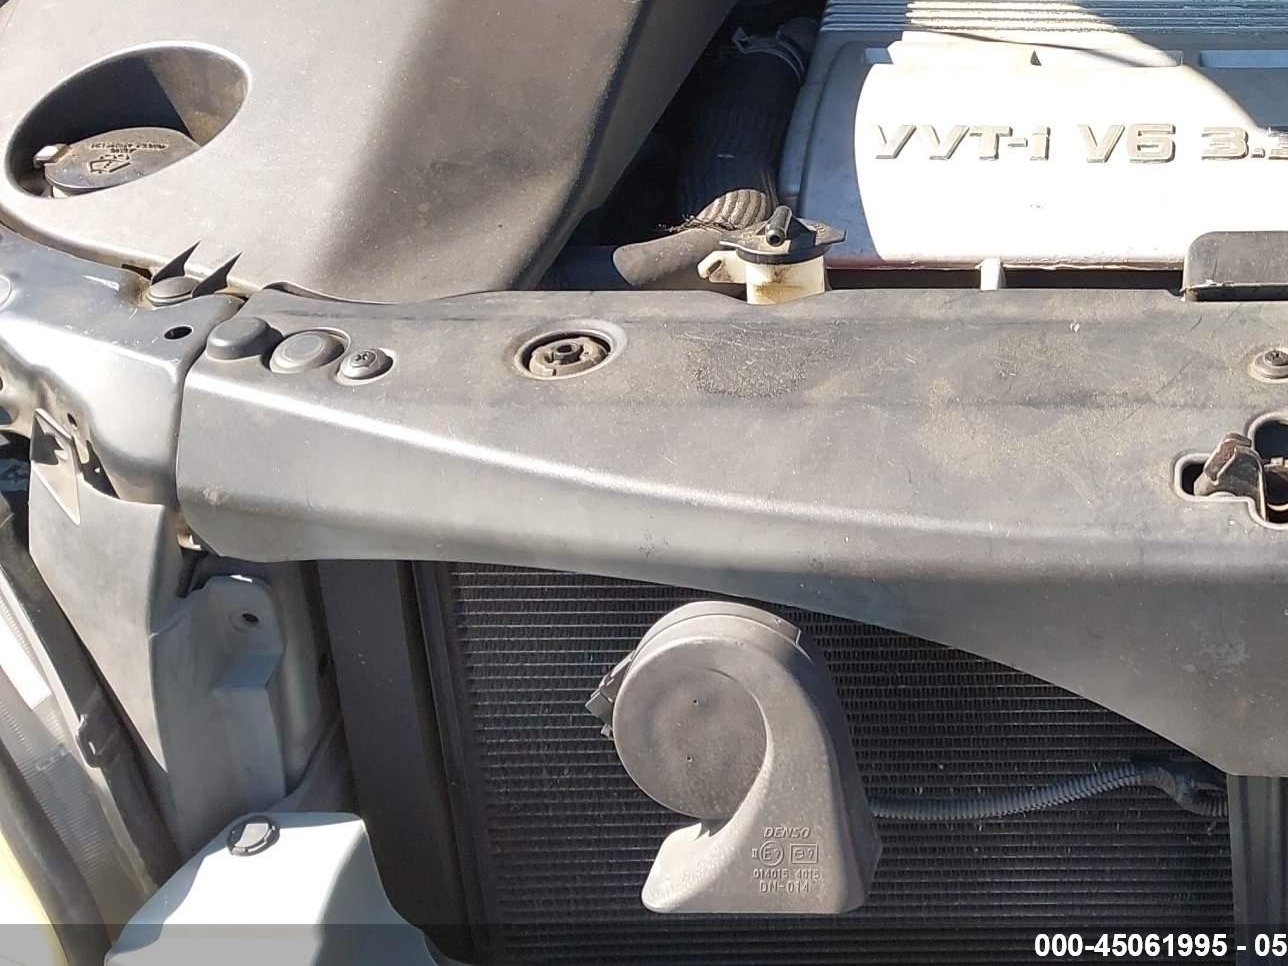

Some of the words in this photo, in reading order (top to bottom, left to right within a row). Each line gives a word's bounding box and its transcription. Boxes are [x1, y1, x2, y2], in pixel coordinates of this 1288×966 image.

[1077, 123, 1176, 163] V6
[763, 826, 812, 840] DENSO
[759, 880, 811, 894] DN-014
